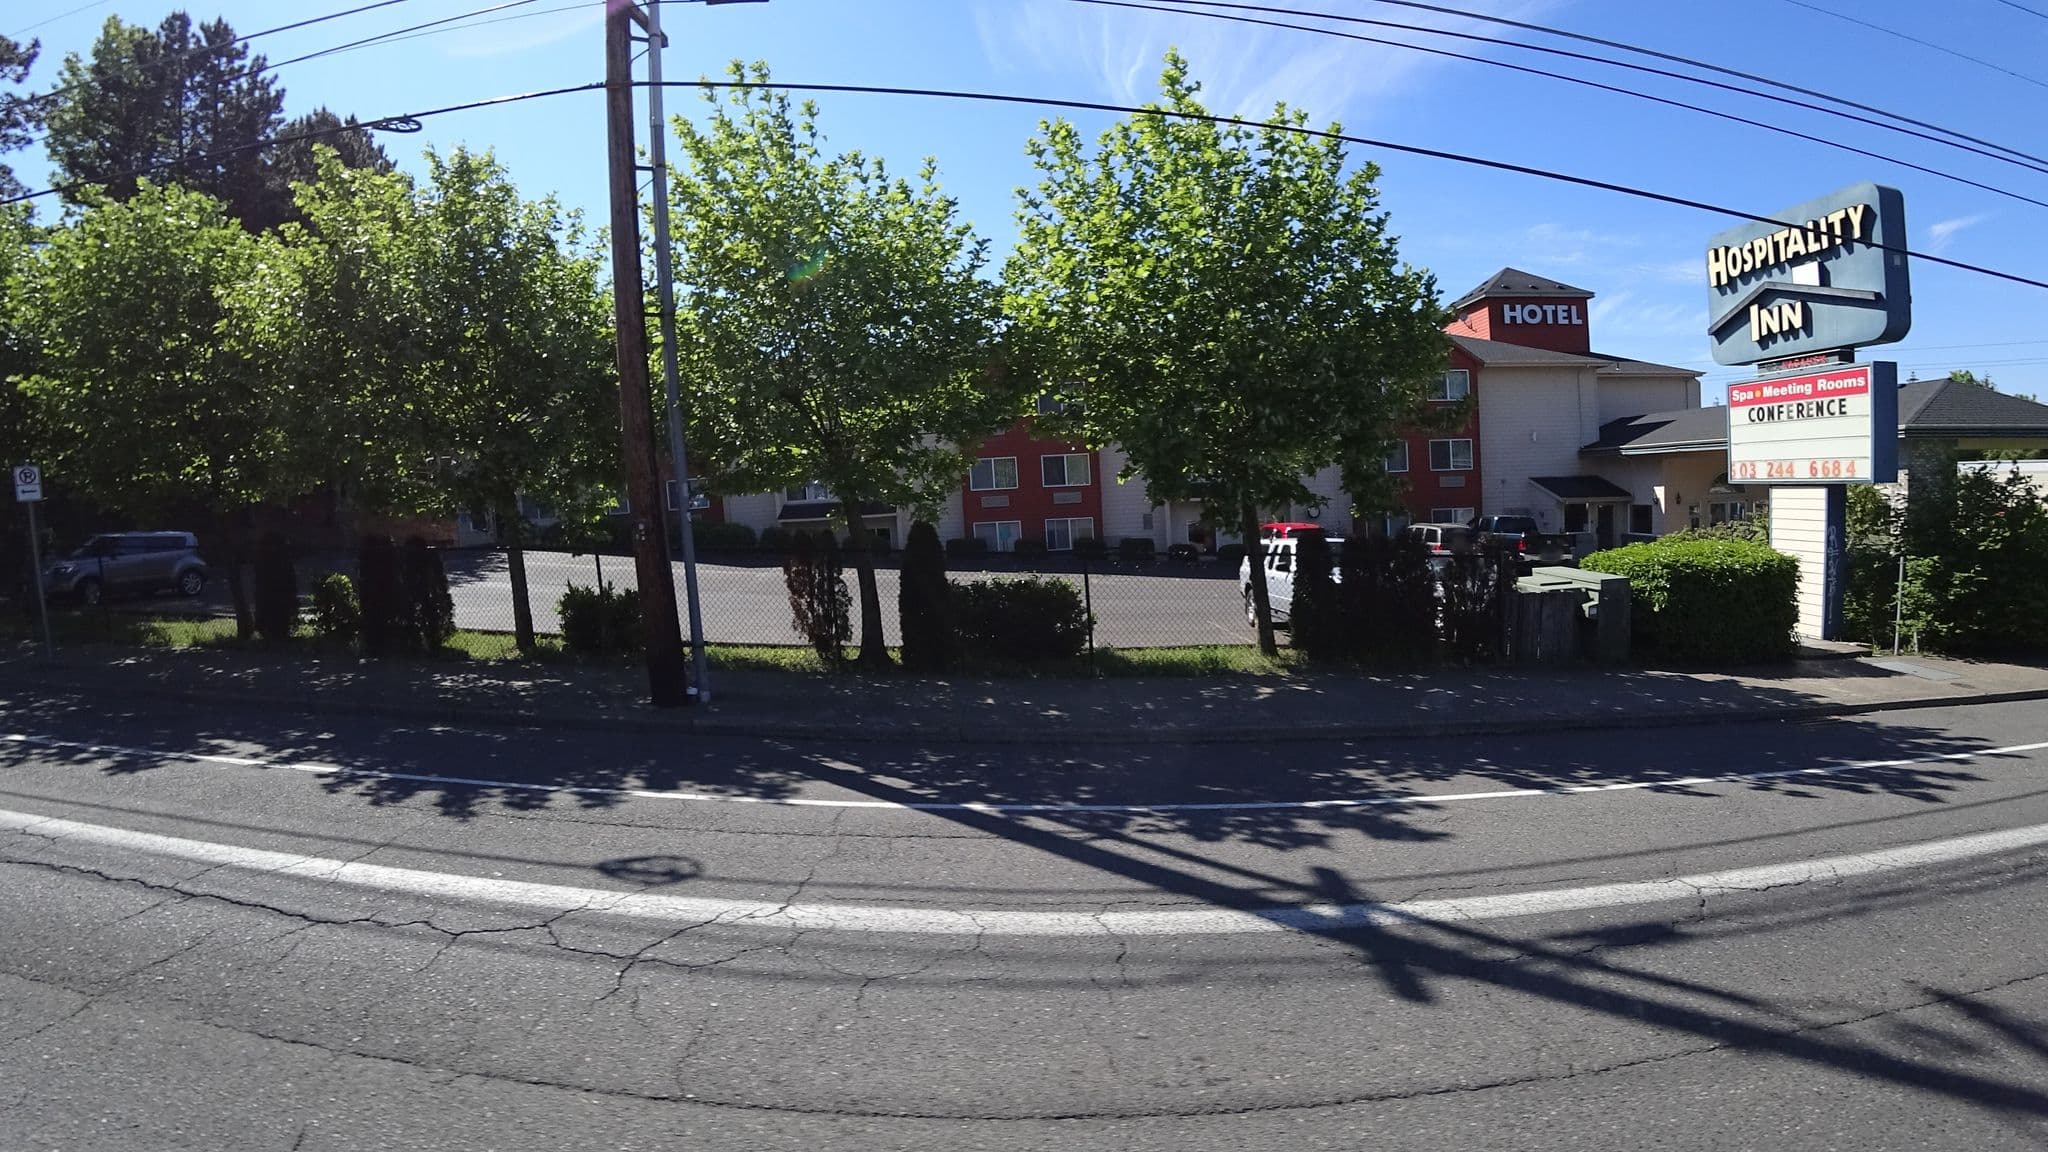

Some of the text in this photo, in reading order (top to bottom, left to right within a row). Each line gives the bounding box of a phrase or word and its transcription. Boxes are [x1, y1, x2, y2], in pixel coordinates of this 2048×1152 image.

[1708, 204, 1864, 287] HOSPITALITY
[1503, 304, 1583, 324] HOTEL
[1750, 301, 1802, 342] INN
[1732, 376, 1865, 402] Spa Meeting Rooms
[1748, 398, 1847, 422] CONFERENCE
[1767, 461, 1793, 477] 244
[1808, 460, 1856, 477] 6684
